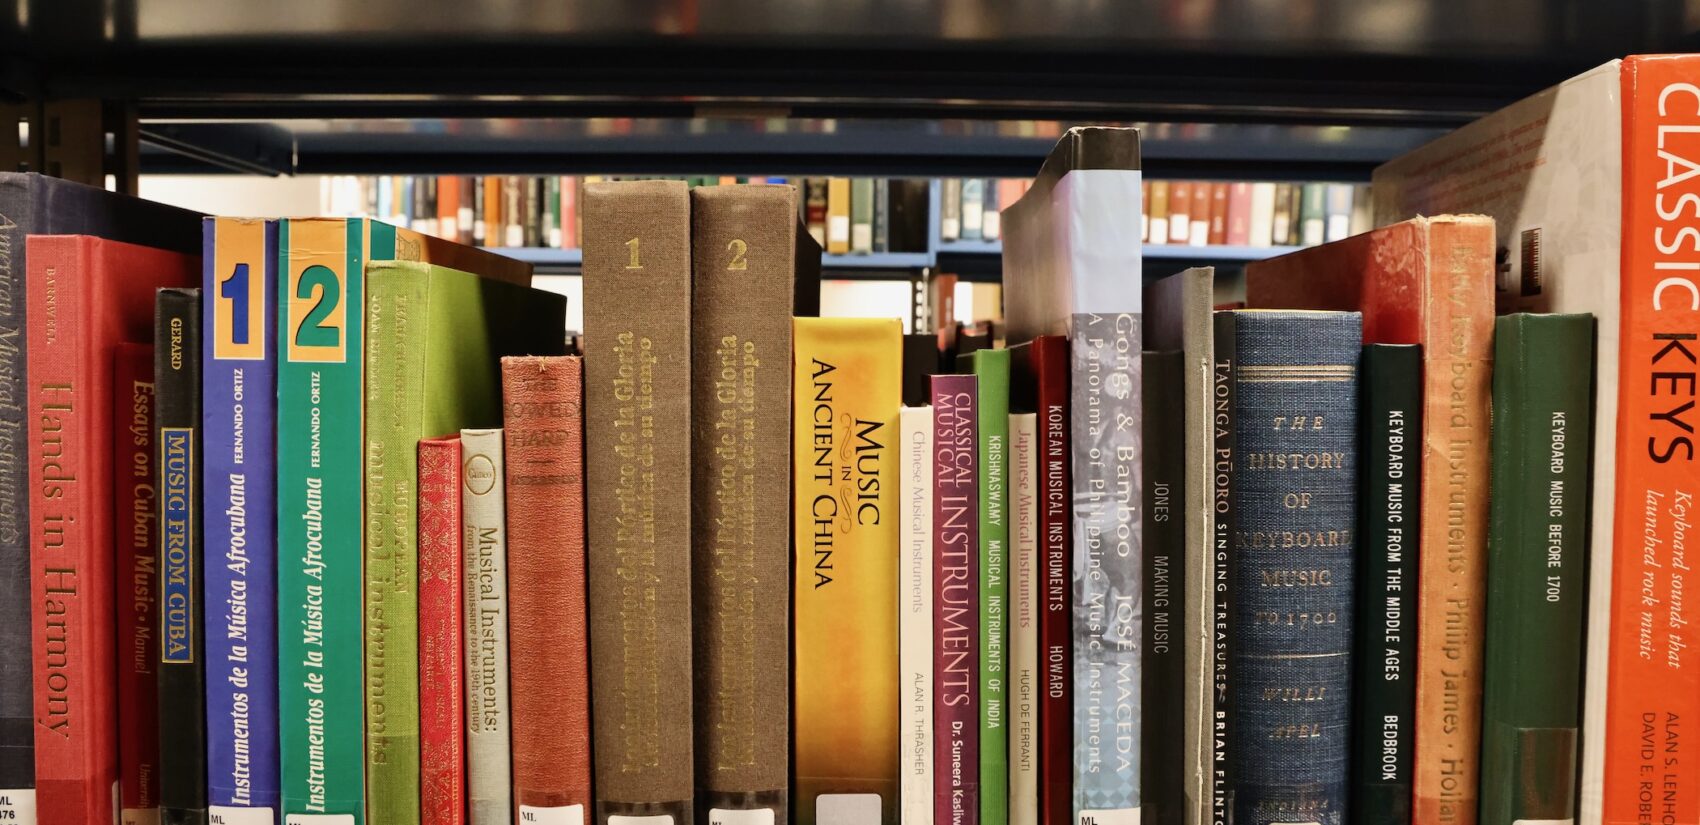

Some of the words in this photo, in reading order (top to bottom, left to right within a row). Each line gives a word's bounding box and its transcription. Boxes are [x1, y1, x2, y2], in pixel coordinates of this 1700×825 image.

[1652, 83, 1700, 311] CLASSIC
[625, 238, 643, 268] 1
[727, 239, 747, 270] 2
[46, 268, 58, 345] BARNWELL
[221, 263, 249, 344] 1
[295, 265, 340, 347] 2
[370, 295, 382, 334] JOAN
[1088, 313, 1103, 325] A
[0, 326, 20, 411] Musical
[170, 318, 183, 370] GERARD
[614, 331, 634, 401] Gloria
[716, 335, 737, 404] Gloria
[1112, 313, 1134, 400] Gongs
[233, 368, 244, 402] ORTIZ
[311, 371, 321, 404] ORTIZ
[636, 337, 656, 409] tiempo
[739, 341, 760, 414] tiempo
[1088, 338, 1104, 436] Panorama
[1216, 359, 1230, 438] TAONGA
[1449, 316, 1473, 430] Keyboard
[1648, 333, 1697, 463] KEYS
[133, 381, 155, 446] Essays
[234, 404, 244, 464] FERNANDO
[311, 407, 321, 467] FERNANDO
[614, 407, 634, 428] la
[642, 416, 653, 438] su
[716, 407, 737, 429] la
[743, 417, 755, 439] su
[812, 358, 837, 485] ANCIENT
[1049, 405, 1063, 457] KOREAN
[1116, 413, 1134, 432] &
[1273, 416, 1324, 430] THE
[40, 382, 76, 501] Hands
[134, 453, 148, 477] on
[615, 431, 635, 459] de
[637, 442, 654, 466] de
[716, 432, 737, 460] de
[740, 444, 755, 469] de
[912, 431, 925, 482] Chinese
[937, 393, 954, 487] MUSICAL
[955, 392, 972, 488] CLASSICAL
[1015, 430, 1031, 489] Japanese
[1089, 449, 1106, 468] of
[1249, 453, 1345, 469] HISTORY
[1388, 410, 1403, 479] KEYBOARD
[1550, 412, 1566, 474] KEYBOARD
[167, 436, 187, 511] MUSIC
[841, 466, 852, 480] IN
[856, 418, 884, 525] MUSIC
[988, 435, 1001, 526] KRISHNASWAMY
[1049, 461, 1063, 516] MUSICAL
[1217, 448, 1233, 514] PŪORO
[133, 483, 155, 548] Cuban
[369, 440, 392, 563] musical
[912, 487, 925, 534] Musical
[1018, 494, 1032, 544] Musical
[1116, 447, 1136, 558] Bamboo
[1154, 481, 1169, 522] JONES
[1284, 492, 1312, 508] OF
[1387, 483, 1403, 523] MUSIC
[1447, 440, 1472, 576] Instruments
[1549, 480, 1563, 518] MUSIC
[43, 516, 75, 548] in
[226, 474, 250, 576] Afrocubana
[302, 478, 326, 580] Afrocubana
[467, 525, 477, 550] from
[812, 495, 837, 589] CHINA
[1087, 480, 1105, 580] Philippine
[1387, 528, 1402, 563] FROM
[1548, 524, 1562, 568] BEFORE
[1644, 489, 1664, 568] launched
[1668, 490, 1692, 569] Keyboard
[167, 520, 187, 584] FROM
[468, 554, 477, 567] the
[479, 526, 499, 600] Musical
[912, 537, 925, 613] Instruments
[988, 540, 1000, 588] MUSICAL
[1048, 522, 1063, 611] INSTRUMENTS
[1217, 524, 1227, 591] SINGING
[134, 553, 155, 614] Music
[468, 571, 478, 635] Renaissance
[941, 496, 970, 706] INSTRUMENTS
[1018, 547, 1032, 628] Instruments
[1154, 556, 1168, 607] MAKING
[1262, 569, 1332, 587] MUSIC
[1386, 568, 1401, 591] THE
[1546, 575, 1561, 602] 1700
[1642, 573, 1661, 606] rock
[1669, 573, 1688, 629] sounds
[168, 594, 187, 656] CUBA
[226, 581, 248, 642] Música
[302, 585, 324, 646] Música
[988, 595, 1001, 672] INSTRUMENTS
[1089, 592, 1105, 650] Music
[1116, 595, 1136, 651] JOSÉ
[1154, 612, 1168, 654] MUSIC
[1287, 611, 1337, 631] 1700
[1386, 597, 1400, 643] MIDDLE
[1442, 598, 1469, 660] Philip
[1639, 611, 1656, 661] music
[38, 567, 77, 740] Harmony
[134, 627, 151, 674] Manuel
[228, 644, 248, 663] la
[303, 651, 324, 669] la
[470, 637, 478, 648] to
[471, 653, 479, 666] the
[1215, 602, 1226, 689] TREASURES
[1385, 648, 1400, 681] AGES
[1668, 633, 1686, 668] that
[228, 668, 248, 688] de
[303, 673, 324, 694] de
[368, 573, 392, 765] instruments
[471, 669, 480, 688] 19th
[481, 608, 500, 732] Instruments:
[914, 672, 924, 702] ALAN
[988, 679, 1000, 692] OF
[1020, 669, 1030, 701] HUGH
[1050, 646, 1063, 698] HOWARD
[470, 692, 480, 734] century
[914, 706, 924, 716] R.
[987, 700, 1000, 729] INDIA
[1020, 704, 1030, 718] DE
[1088, 663, 1104, 773] Instruments
[1116, 662, 1132, 772] MACEDA
[1441, 669, 1467, 734] James
[229, 693, 250, 806] Instrumentos
[914, 720, 925, 775] THRASHER
[951, 720, 963, 737] Dr.
[1020, 721, 1030, 771] FERRANTI
[1215, 711, 1226, 761] BRIAN
[1382, 715, 1398, 781] BEDBROOK
[1641, 712, 1656, 760] DAVID
[1665, 712, 1680, 753] ALAN
[304, 699, 325, 812] Instrumentos
[952, 740, 963, 787] Suneera
[1640, 765, 1654, 776] E.
[1664, 757, 1679, 769] S.
[210, 814, 225, 825] ML
[522, 812, 537, 822] ML
[1081, 816, 1098, 825] ML
